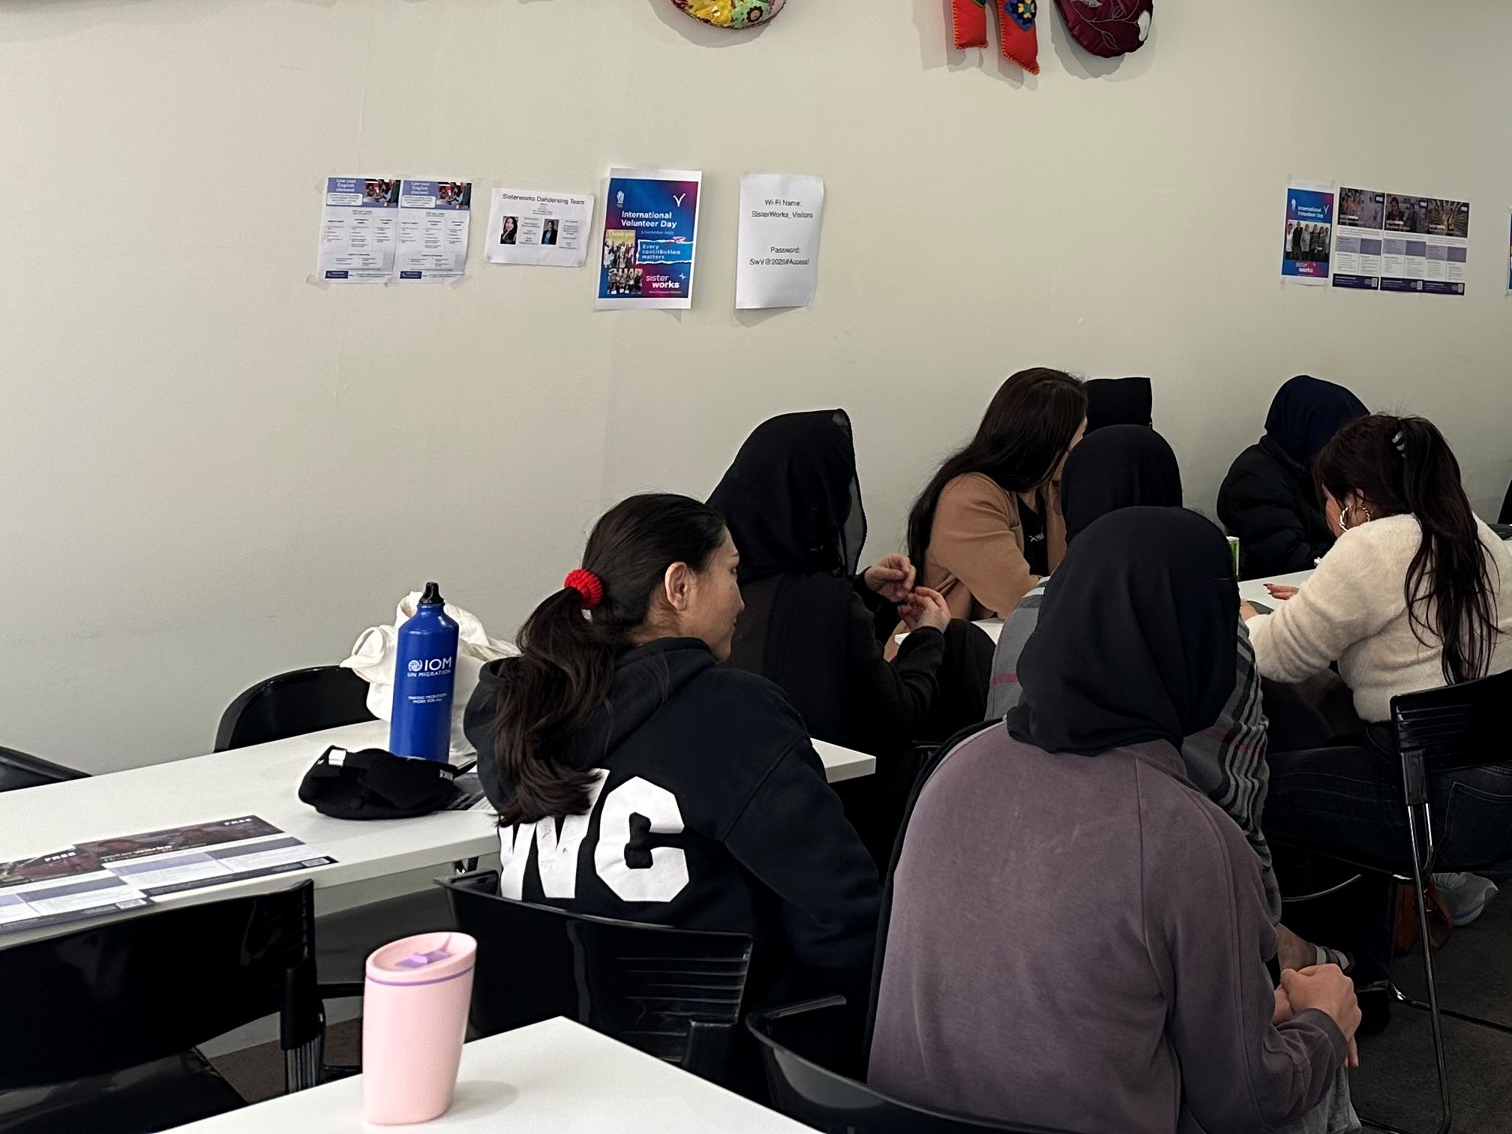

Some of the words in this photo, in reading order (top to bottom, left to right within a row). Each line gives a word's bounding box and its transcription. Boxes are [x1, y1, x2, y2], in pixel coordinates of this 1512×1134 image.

[537, 196, 569, 205] Dandenong
[621, 210, 672, 219] International
[660, 220, 677, 229] Day
[651, 280, 680, 288] works
[424, 656, 452, 672] IOM
